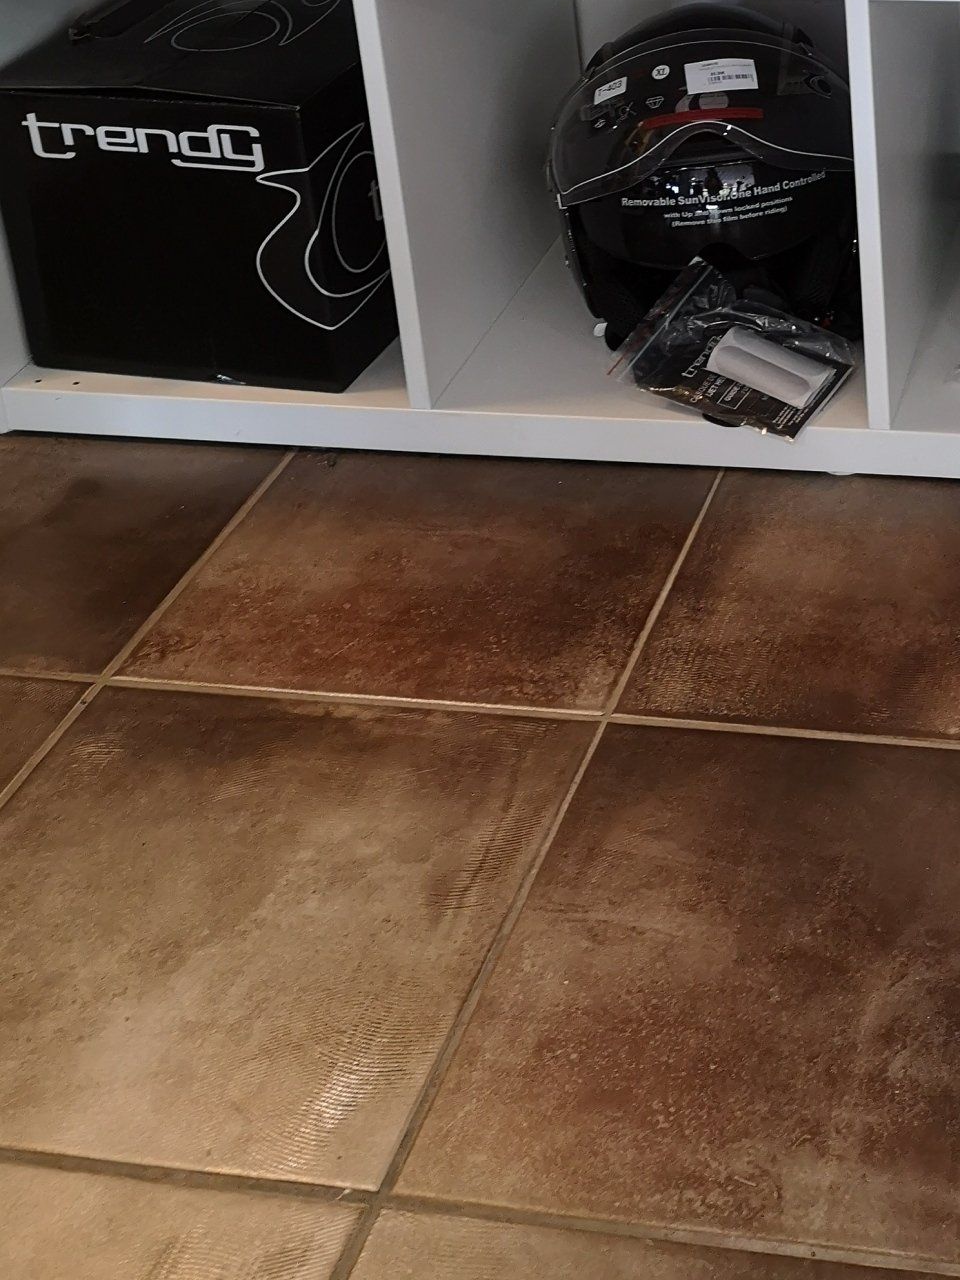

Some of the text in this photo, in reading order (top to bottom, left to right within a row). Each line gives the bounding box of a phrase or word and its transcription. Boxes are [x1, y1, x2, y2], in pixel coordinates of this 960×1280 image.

[22, 113, 265, 172] trendy
[621, 196, 676, 207] Removable
[753, 183, 781, 196] Hand
[782, 170, 826, 190] Controlled
[664, 211, 680, 219] with
[682, 210, 692, 218] Up
[734, 201, 760, 212] locked
[761, 195, 793, 209] positions
[672, 219, 706, 228] (Remove
[739, 211, 763, 221] before
[764, 204, 788, 218] riding)
